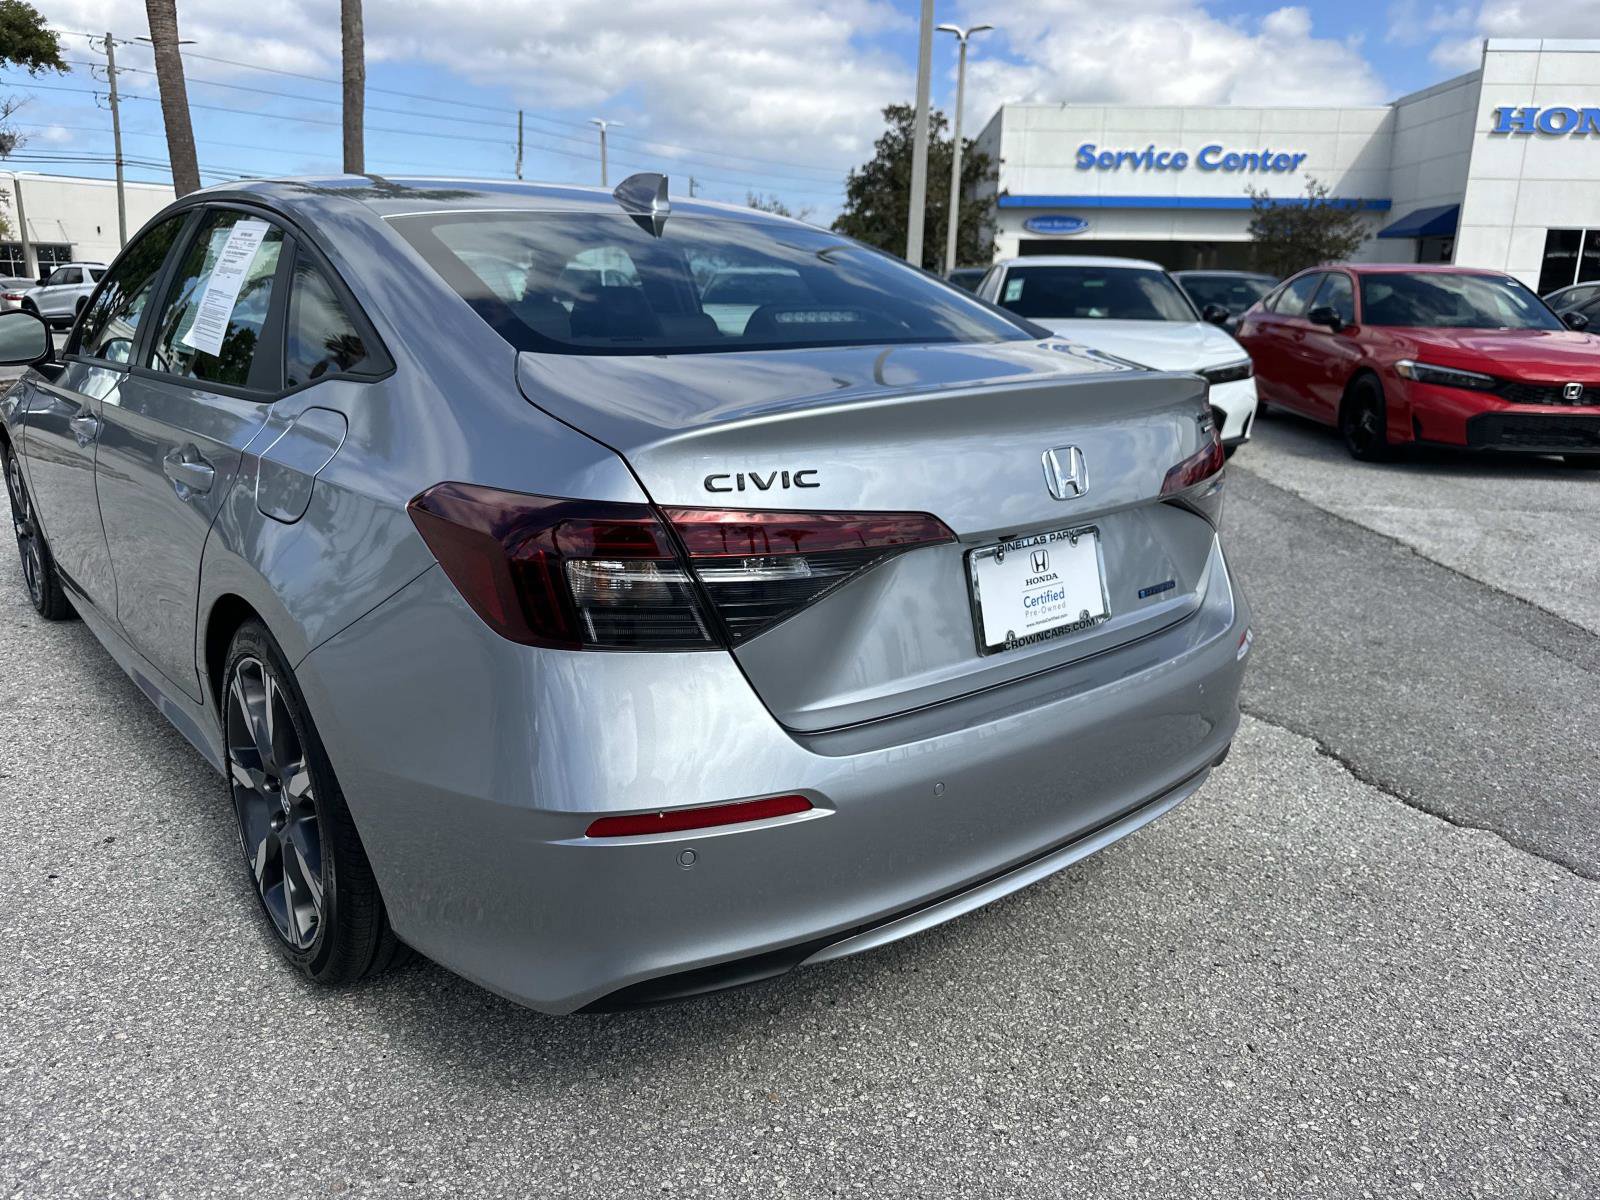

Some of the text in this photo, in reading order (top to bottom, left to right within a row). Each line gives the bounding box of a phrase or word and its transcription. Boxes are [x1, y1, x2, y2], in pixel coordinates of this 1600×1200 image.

[1076, 144, 1307, 171] Service Center
[703, 469, 821, 493] CIVIC
[997, 529, 1076, 553] PINELLAS PARK
[1025, 572, 1058, 586] HONDA
[1023, 586, 1065, 609] Certified
[1025, 601, 1066, 617] Pre-Owned
[1003, 618, 1095, 650] CROWNCARS.COM
